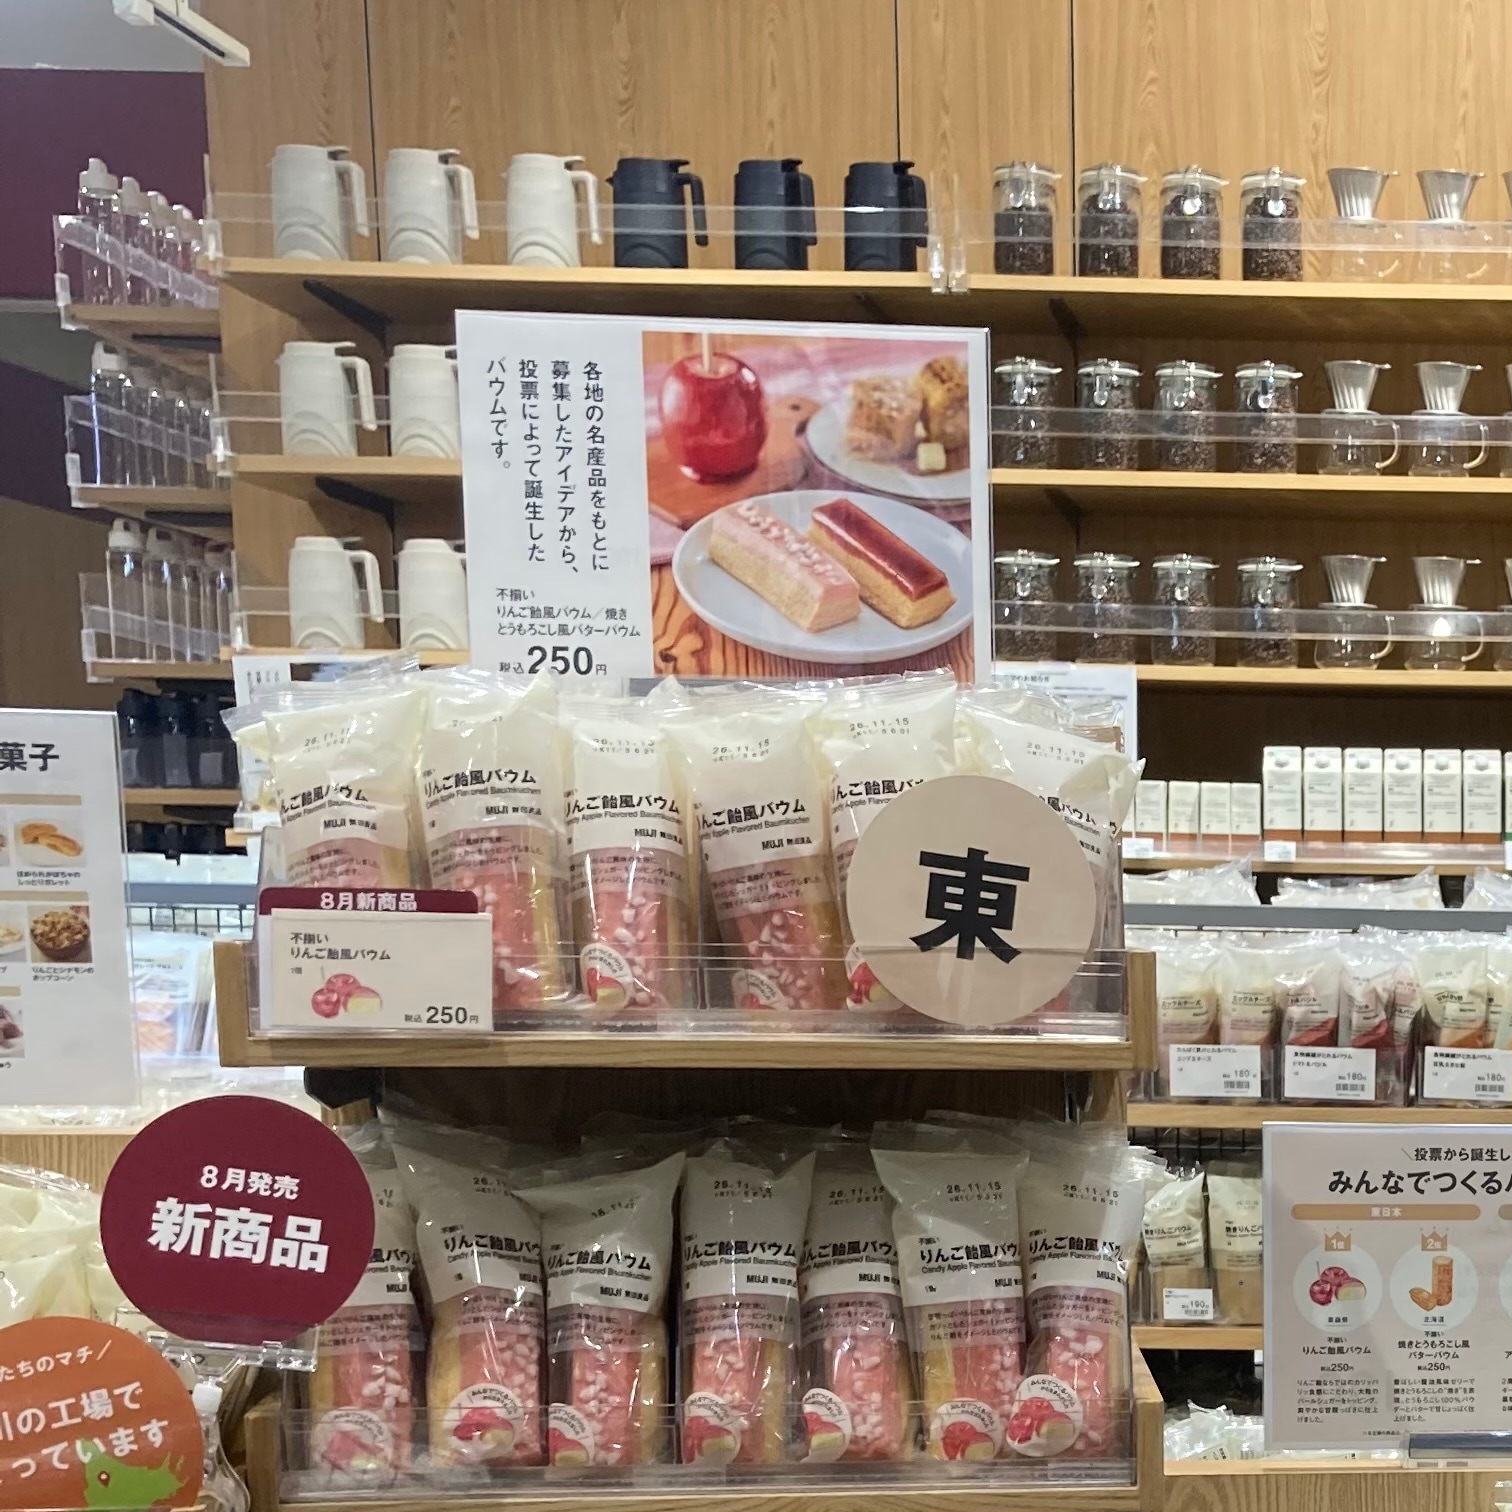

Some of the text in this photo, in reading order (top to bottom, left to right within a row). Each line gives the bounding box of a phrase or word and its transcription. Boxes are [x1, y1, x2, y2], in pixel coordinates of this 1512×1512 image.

[487, 357, 511, 469] バウムです。
[519, 359, 545, 562] 投票によって誕生した
[551, 360, 578, 573] 募集したアイデアから、
[583, 361, 609, 571] 各地の名産品をもとに
[496, 588, 535, 601] 不揃い
[497, 623, 640, 638] とうもろこし風バターバウム
[0, 742, 60, 772] 菓子
[424, 769, 536, 797] りんご飴風バウム
[485, 805, 509, 816] MUJI
[762, 838, 783, 851] MUJI
[320, 891, 417, 911] 8月新商品
[909, 847, 1030, 965] 東
[290, 947, 391, 961] りんご飴風バウム
[199, 1165, 301, 1201] 8月発売
[147, 1197, 329, 1274] 新商品
[548, 1251, 651, 1271] りんご飴風バウム
[1302, 1346, 1371, 1355] りんご飴風バウム
[1398, 1340, 1470, 1349] 焼きとうもろこし風
[1408, 1351, 1460, 1360] バターバウム
[0, 1418, 169, 1482] っています
